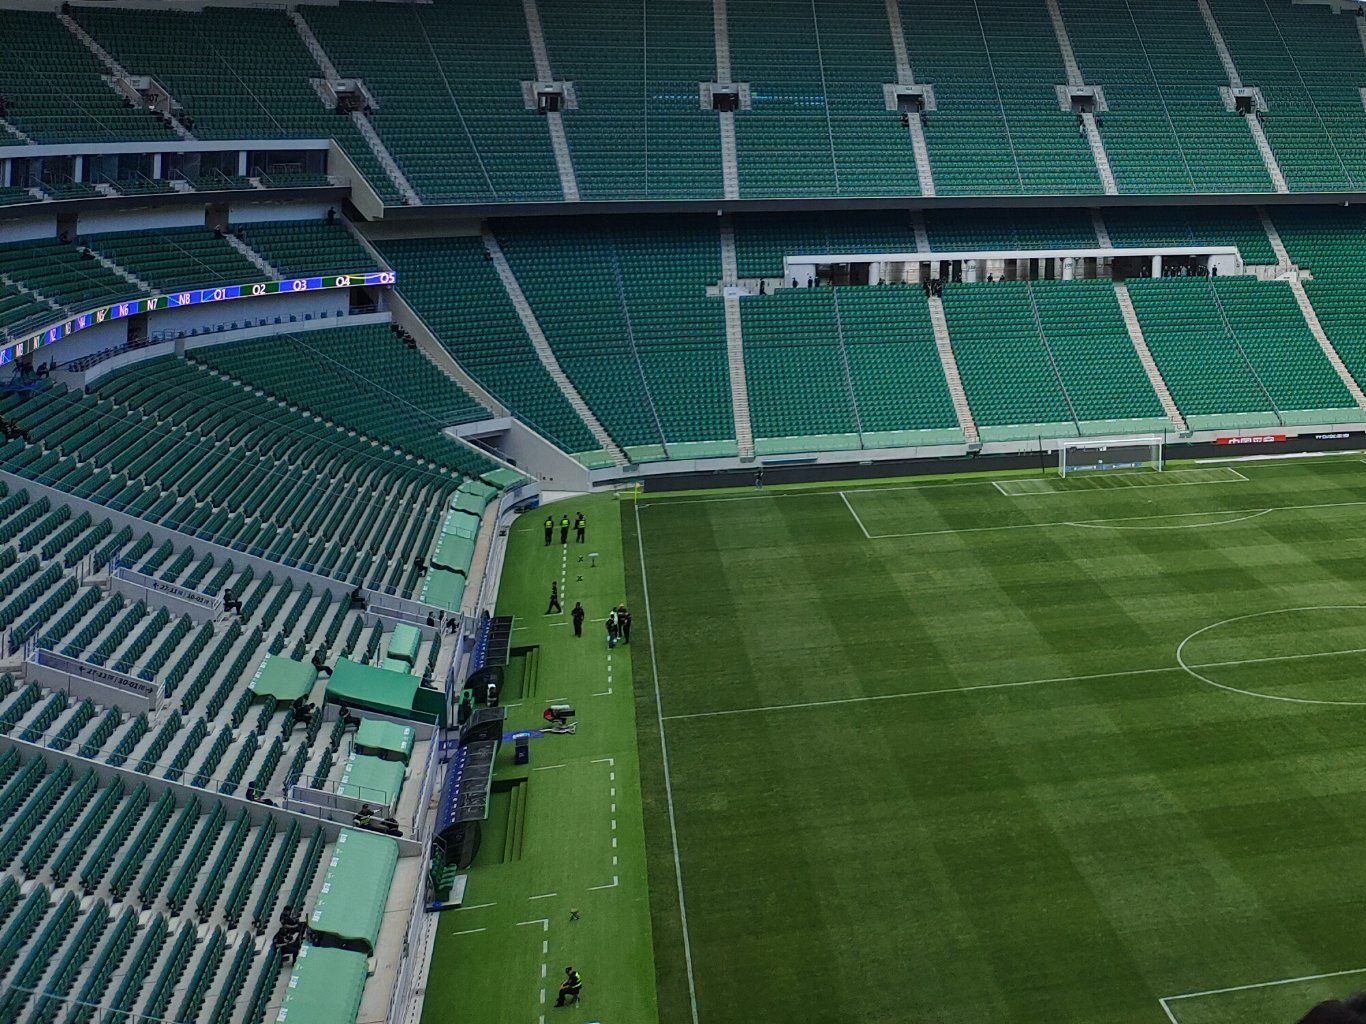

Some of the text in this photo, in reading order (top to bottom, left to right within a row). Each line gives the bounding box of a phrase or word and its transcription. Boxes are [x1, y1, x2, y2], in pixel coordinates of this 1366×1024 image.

[119, 304, 129, 316] N6
[147, 298, 157, 310] N7
[179, 293, 190, 305] N8
